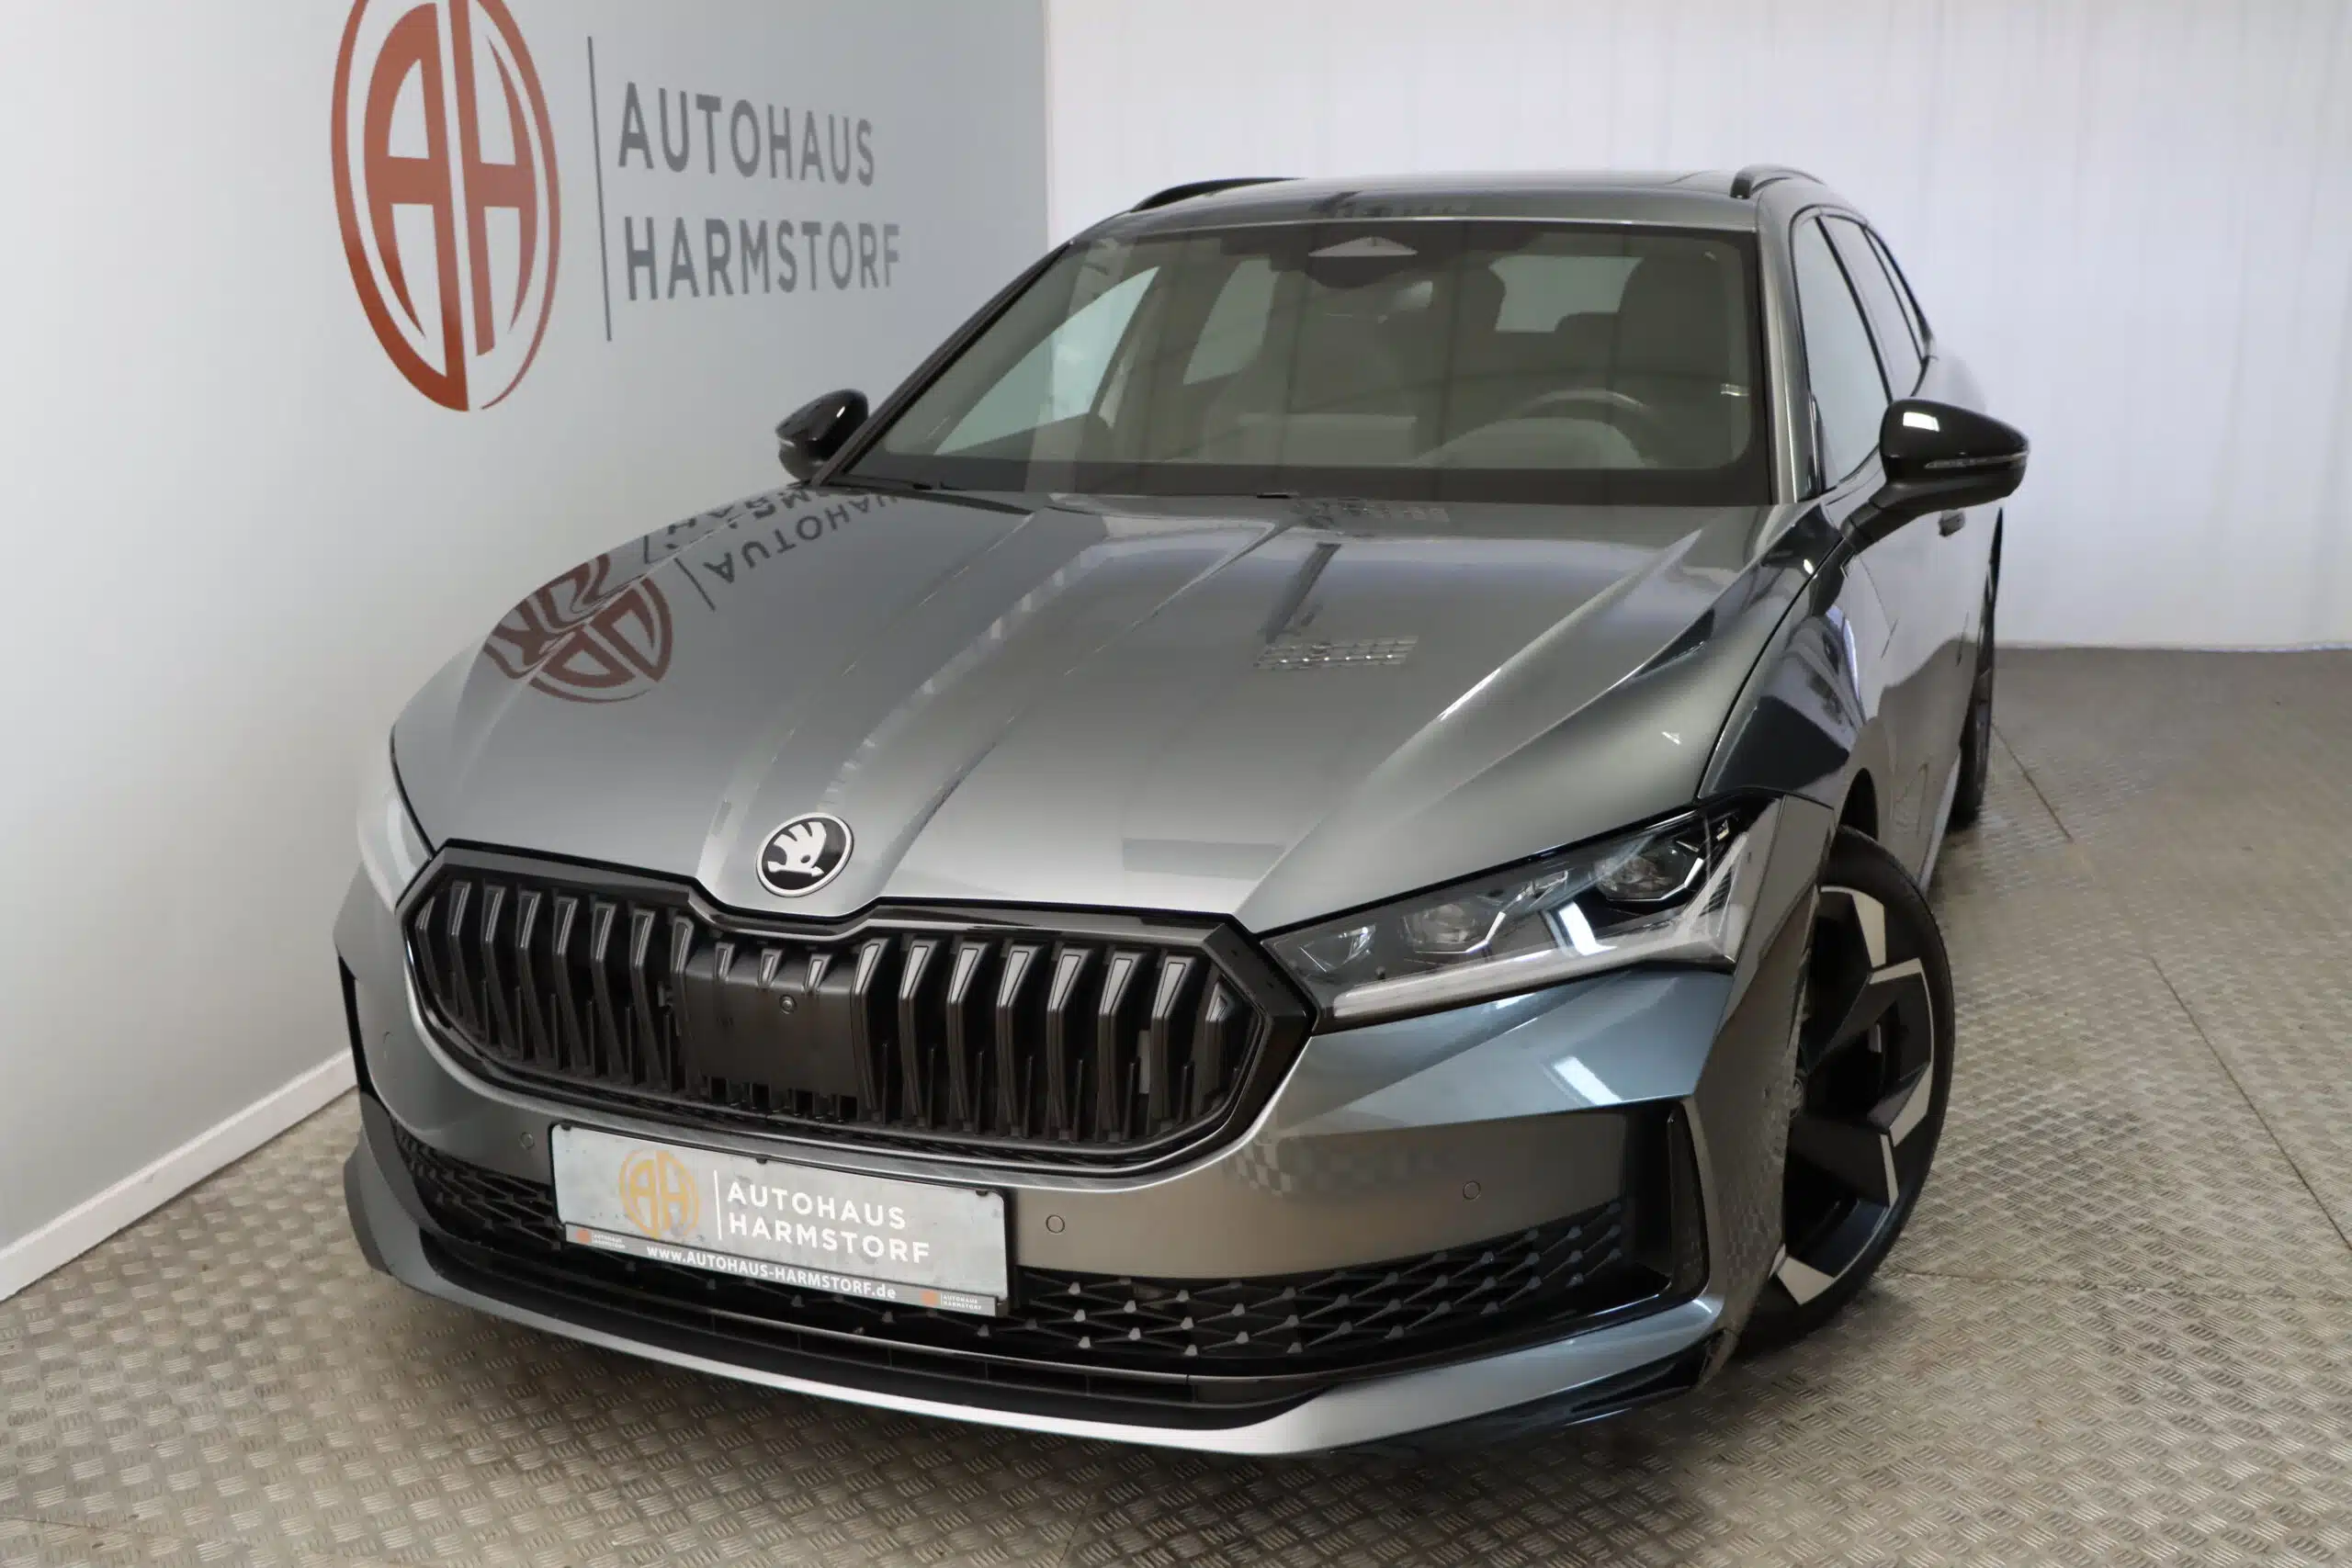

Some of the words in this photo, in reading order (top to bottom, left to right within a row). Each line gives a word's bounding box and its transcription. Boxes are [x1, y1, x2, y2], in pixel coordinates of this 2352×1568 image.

[617, 81, 876, 187] AUTOHAUS
[624, 216, 900, 302] HARMSTORF
[727, 1181, 907, 1230] AUTOHAUS
[729, 1212, 931, 1264] HARMSTORF
[646, 1245, 897, 1300] www.AUTOHAUS-HARMSTORF.de
